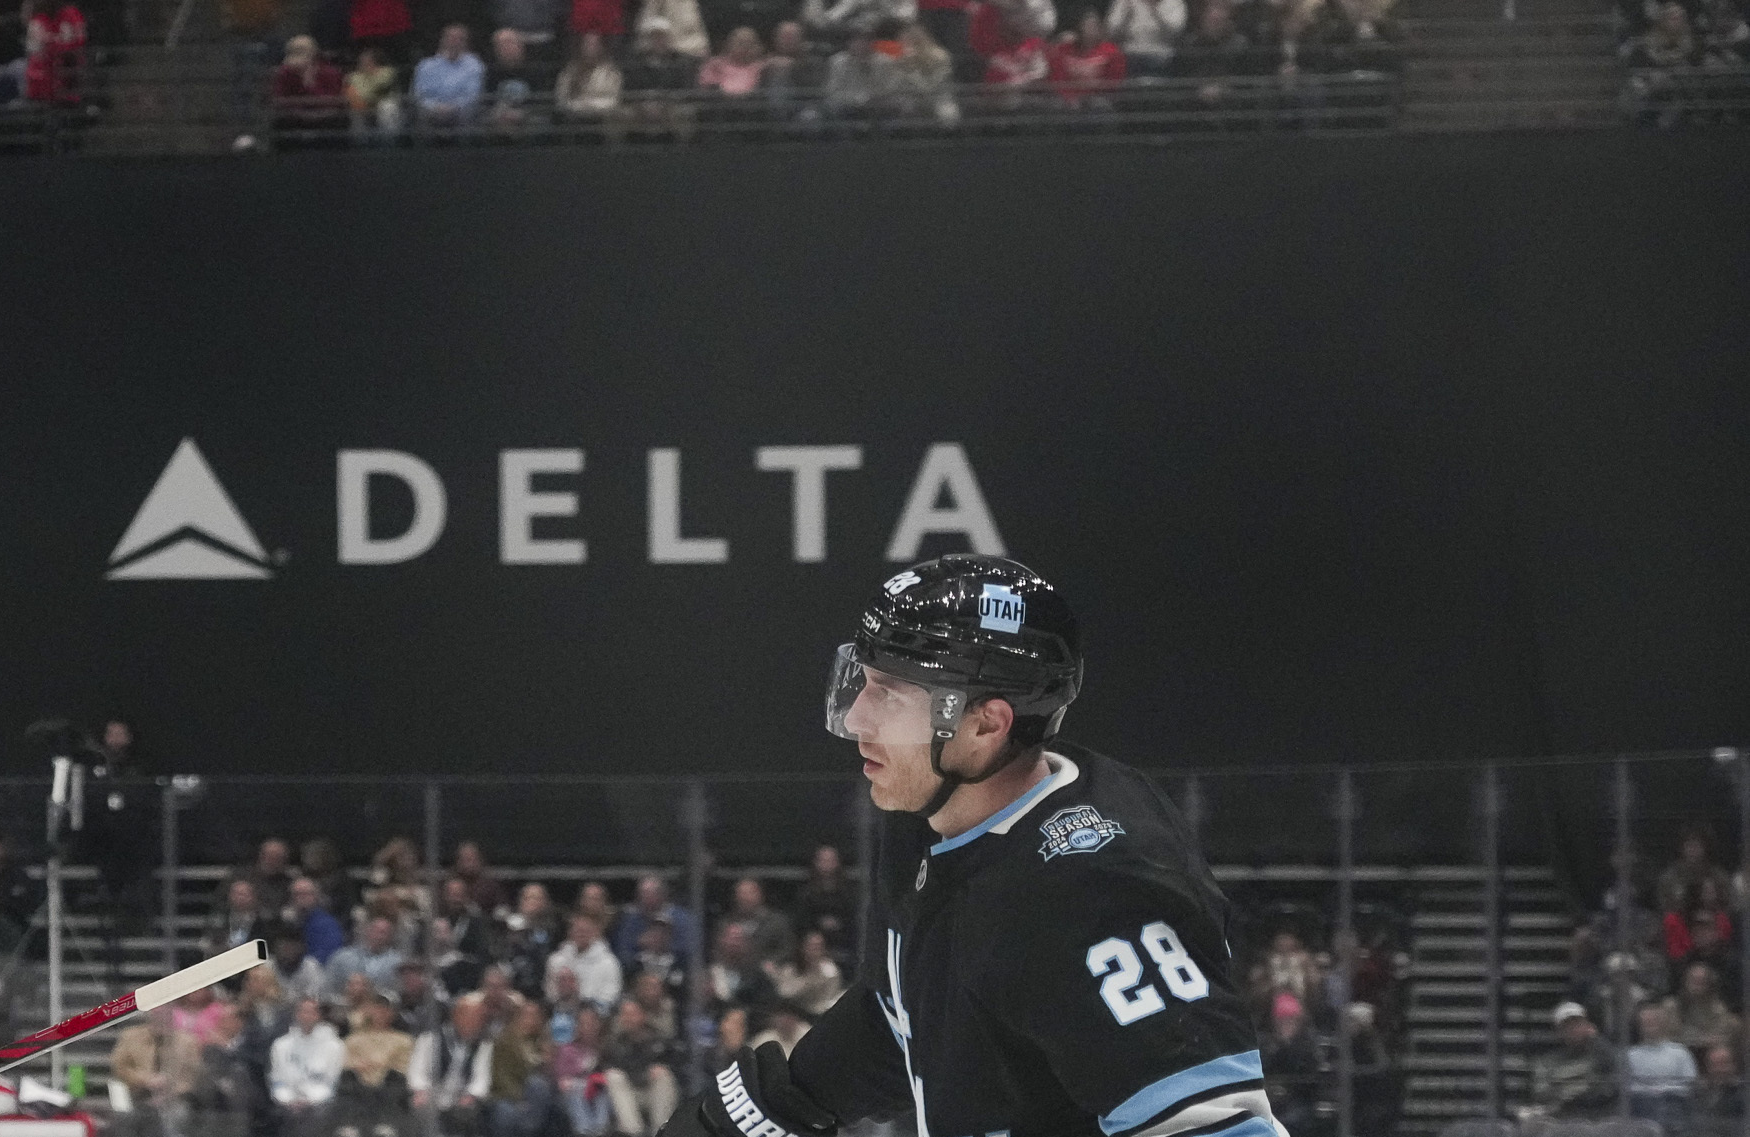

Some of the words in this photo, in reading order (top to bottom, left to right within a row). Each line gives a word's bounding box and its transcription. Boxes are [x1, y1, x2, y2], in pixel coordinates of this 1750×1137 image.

[337, 442, 1008, 565] DELTA
[883, 571, 921, 595] 28
[979, 597, 1026, 624] UTAH
[1050, 814, 1101, 839] SEASON
[1073, 833, 1097, 845] UTAH
[1086, 920, 1210, 1027] 28
